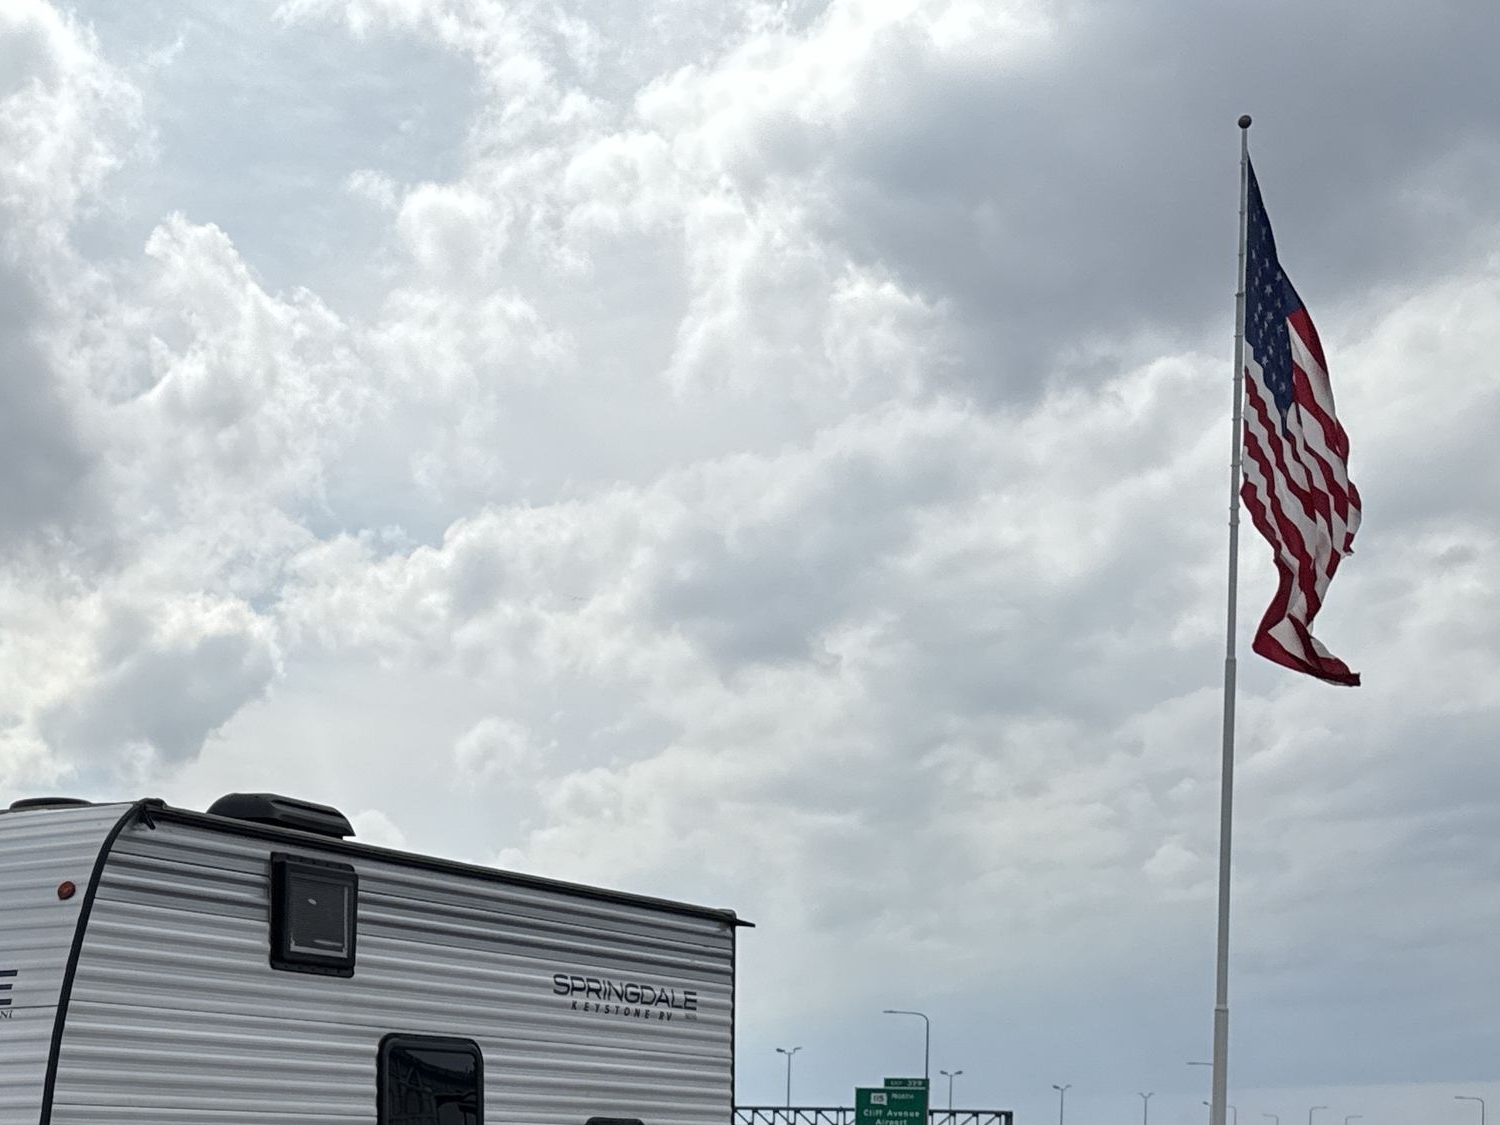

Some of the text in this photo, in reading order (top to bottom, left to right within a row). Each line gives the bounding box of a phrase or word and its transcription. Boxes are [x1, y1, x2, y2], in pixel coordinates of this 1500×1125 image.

[553, 974, 697, 1011] SPRINGDALE
[571, 1000, 650, 1019] KEYSTONE
[659, 1012, 673, 1021] RV
[863, 1109, 920, 1117] Cliff Avenue
